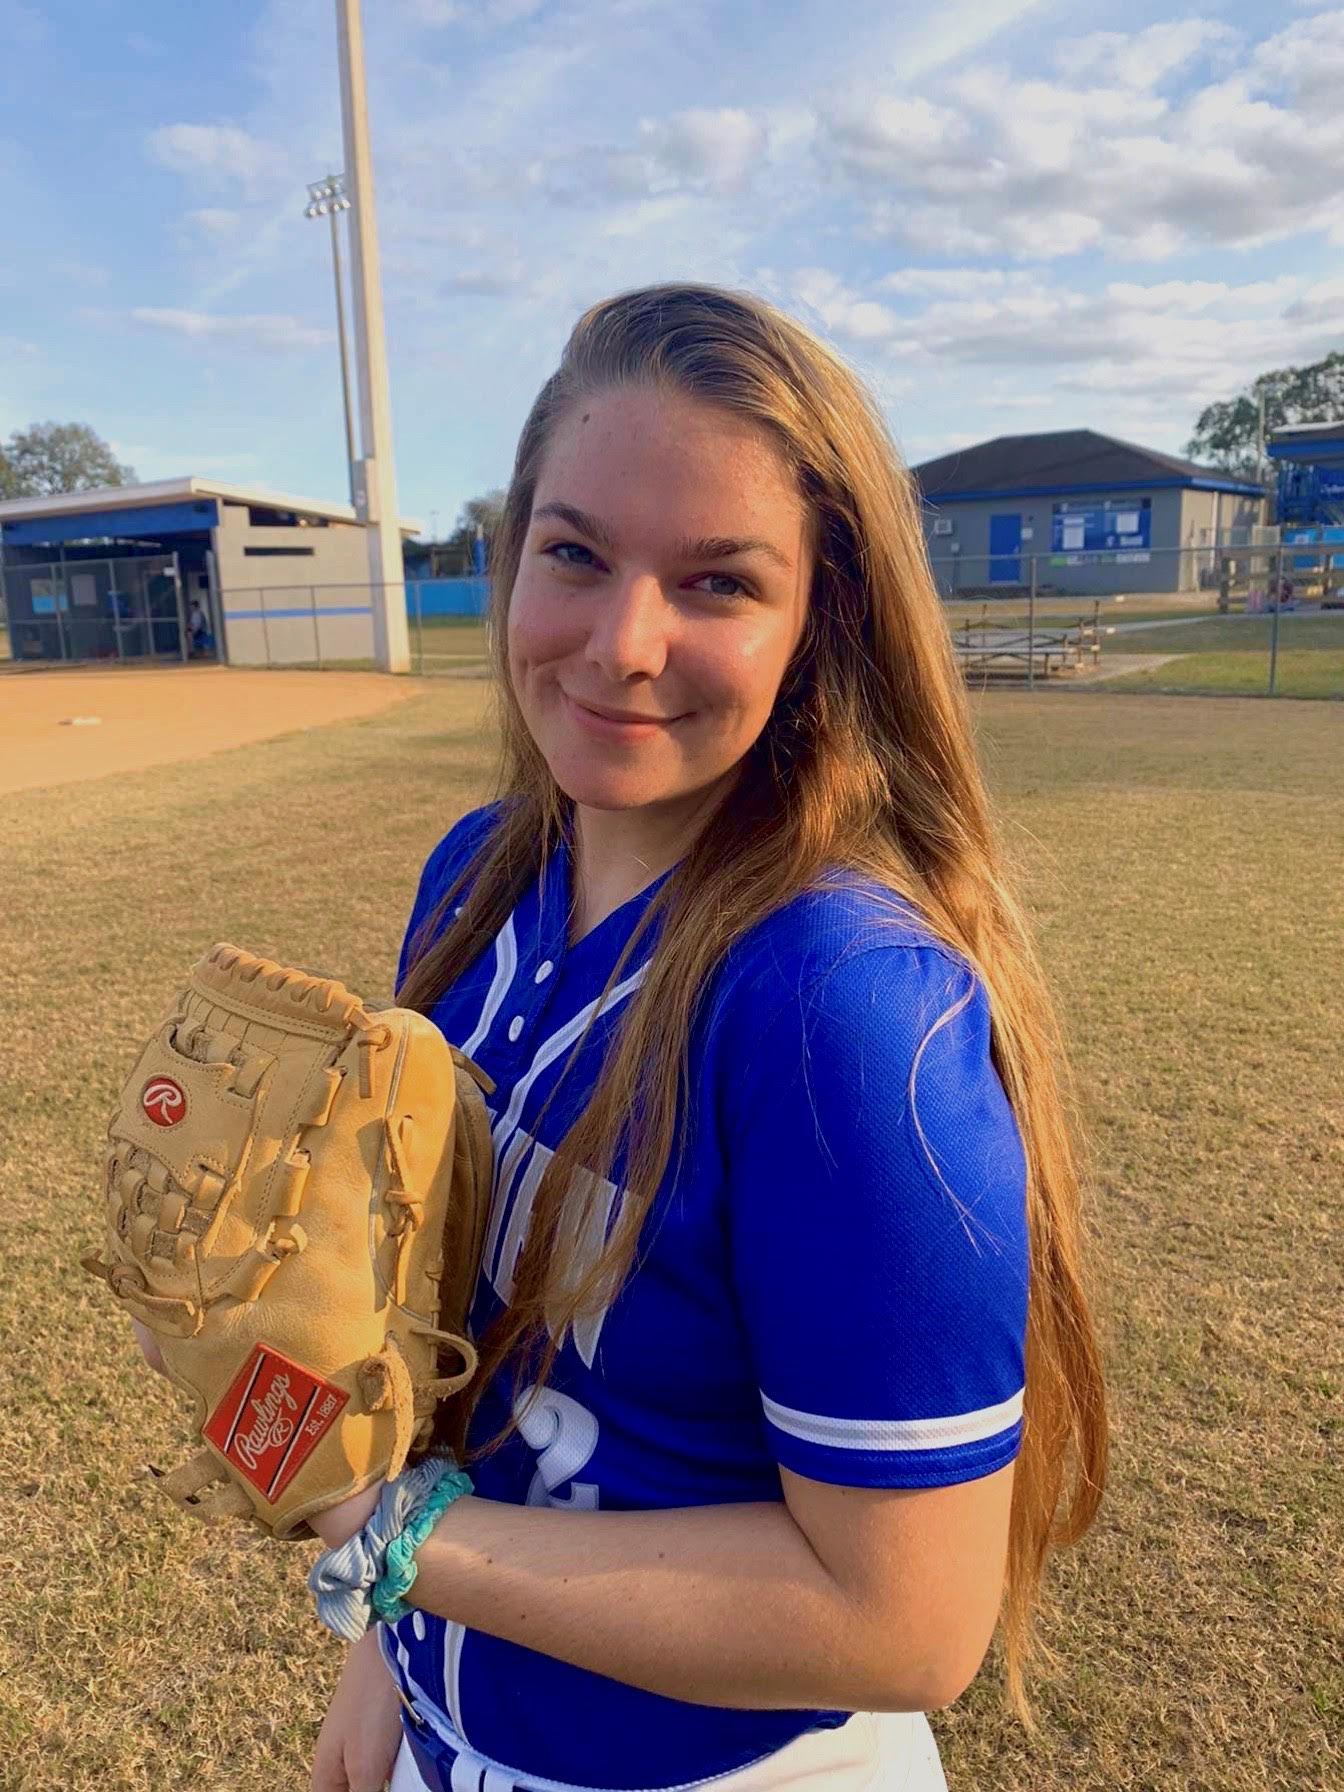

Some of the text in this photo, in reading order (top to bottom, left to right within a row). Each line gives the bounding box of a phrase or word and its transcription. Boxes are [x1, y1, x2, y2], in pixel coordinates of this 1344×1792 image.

[144, 1084, 182, 1124] R
[234, 1373, 298, 1470] Rawlings
[316, 1394, 337, 1418] 1887
[513, 1384, 600, 1511] 2
